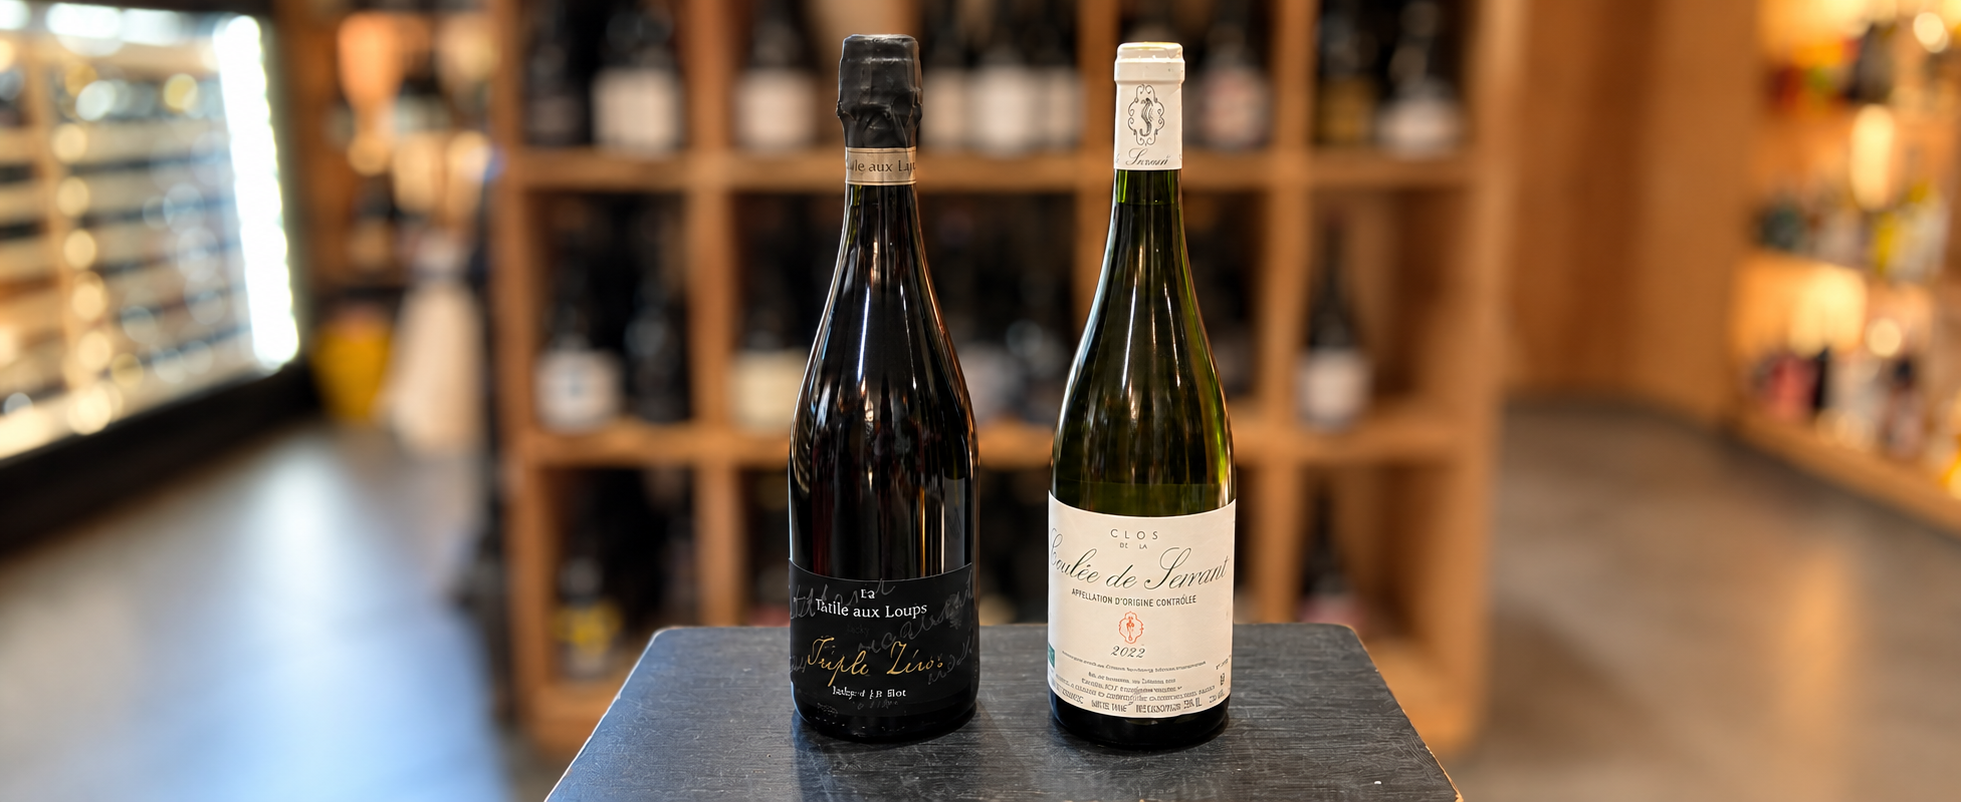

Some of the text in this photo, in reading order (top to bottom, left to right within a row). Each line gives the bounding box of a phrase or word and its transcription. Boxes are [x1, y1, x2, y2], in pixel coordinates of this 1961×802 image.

[868, 163, 893, 172] aux
[1110, 528, 1158, 540] CLOS
[1050, 527, 1230, 590] Coulée de Serrant
[1071, 588, 1113, 604] APPELLATION
[1115, 597, 1154, 608] D'ORIGINE
[853, 606, 881, 618] aux
[885, 604, 928, 619] Loups
[1110, 645, 1146, 659] 2022
